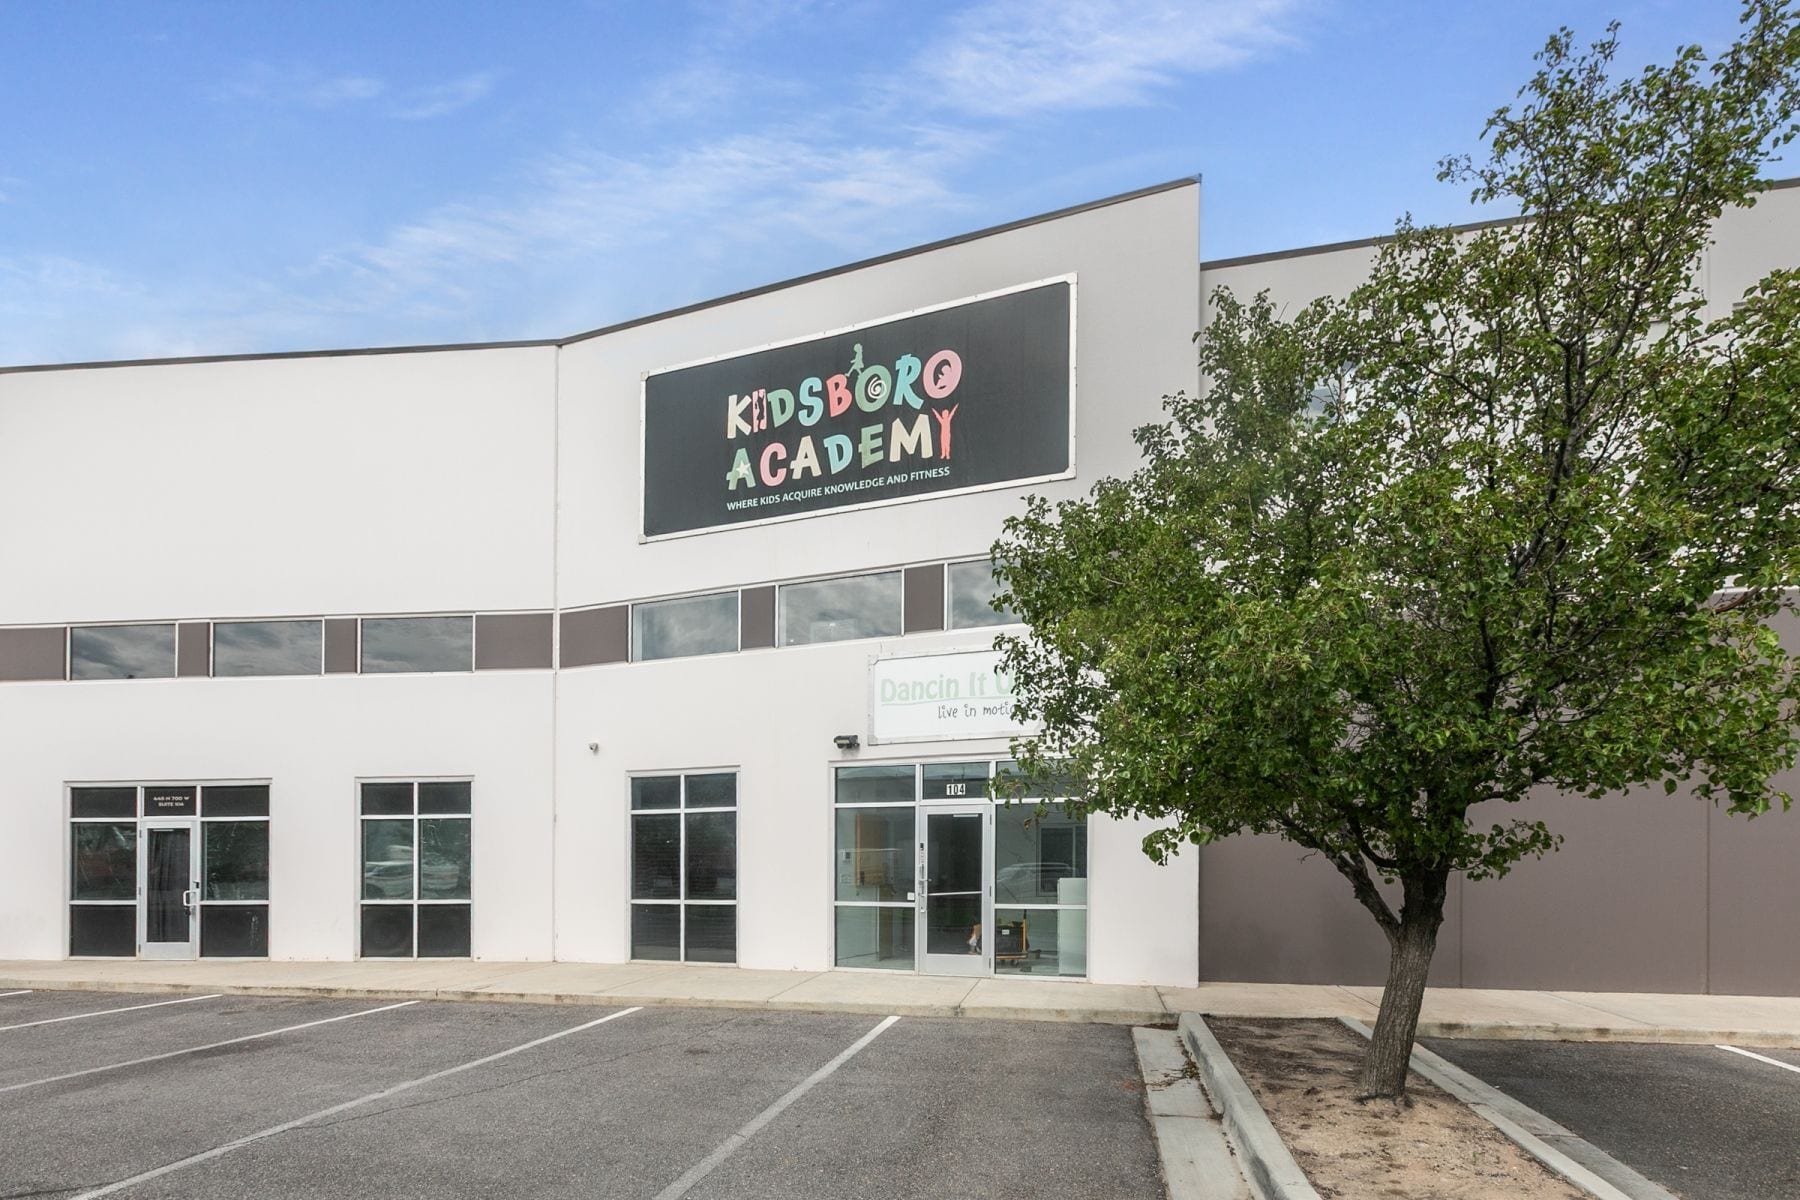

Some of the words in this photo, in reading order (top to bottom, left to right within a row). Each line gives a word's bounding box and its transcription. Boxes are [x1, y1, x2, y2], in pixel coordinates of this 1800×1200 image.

[727, 348, 962, 439] KIDSBORO
[726, 402, 959, 491] ACADEMY
[726, 498, 758, 511] WHERE
[760, 494, 781, 505] KIDS
[782, 487, 822, 502] ACQUIRE
[824, 477, 884, 496] KNOWLEDGE
[886, 473, 908, 485] AND
[910, 466, 950, 481] FITNESS
[881, 674, 959, 702] Dancin
[969, 671, 987, 697] It
[938, 703, 958, 719] live
[964, 703, 977, 718] in
[983, 701, 1018, 716] motio
[947, 784, 965, 795] 104
